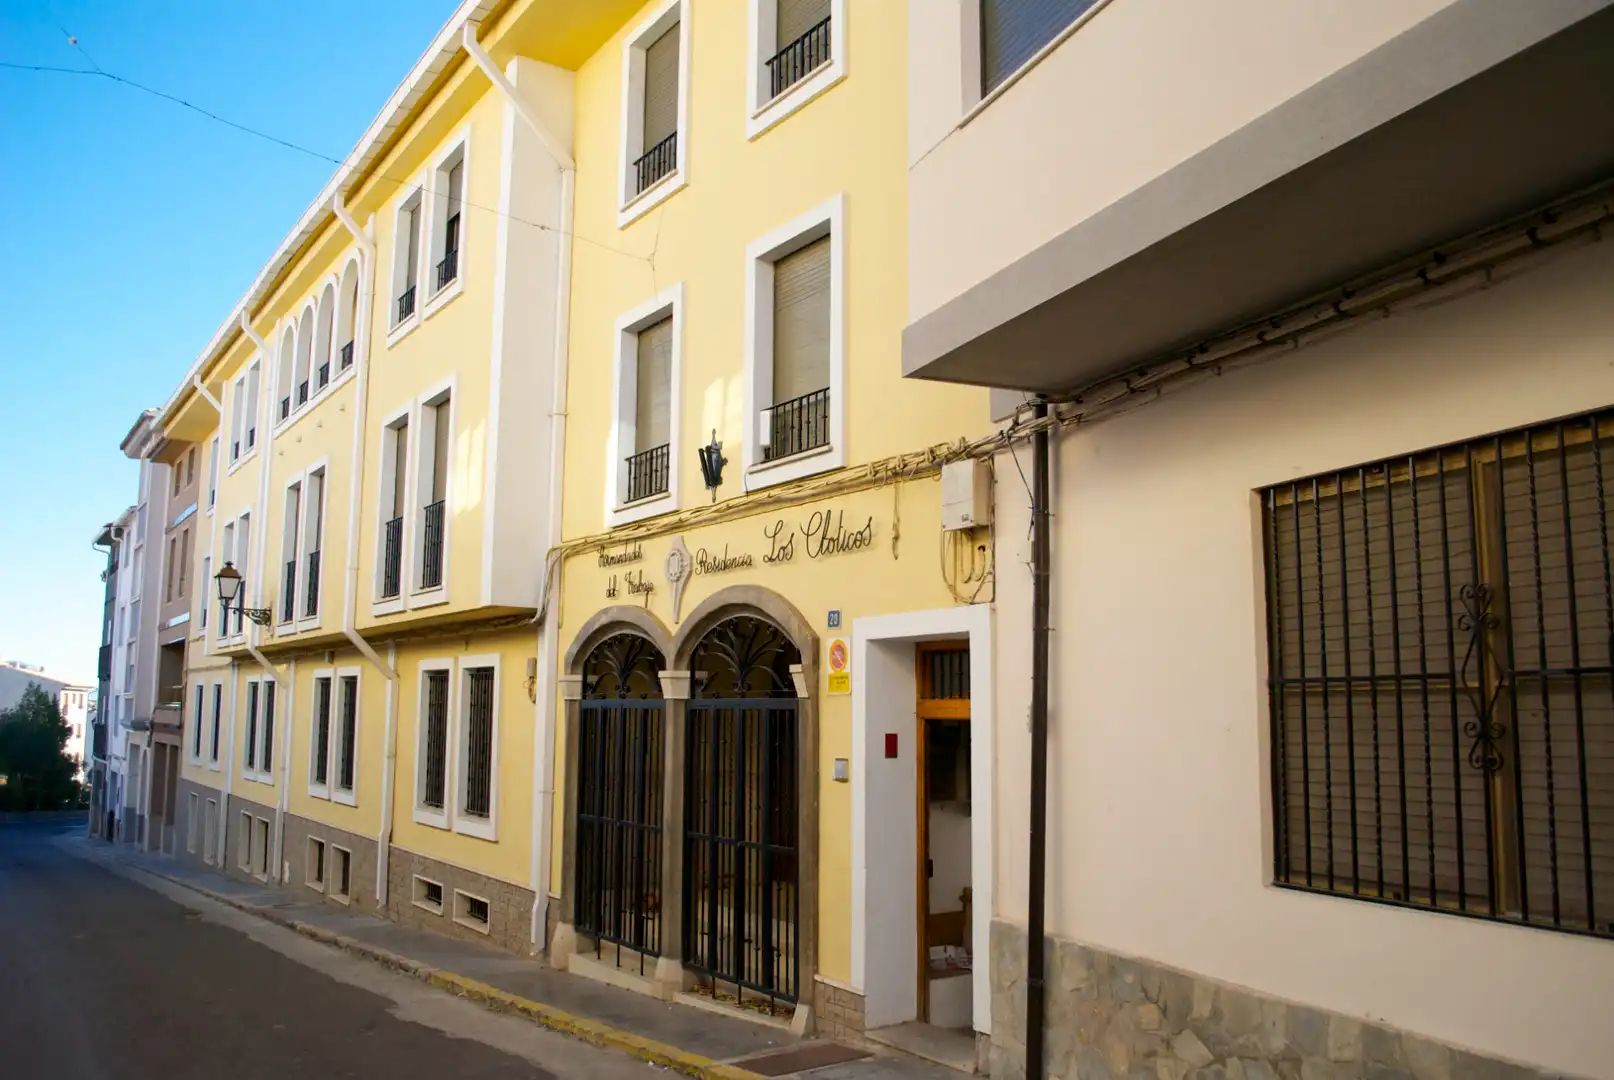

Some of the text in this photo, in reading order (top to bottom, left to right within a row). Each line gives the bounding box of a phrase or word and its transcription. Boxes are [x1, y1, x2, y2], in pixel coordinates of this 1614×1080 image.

[695, 543, 753, 575] Residencia
[763, 520, 795, 563] Los
[829, 613, 838, 625] 20
